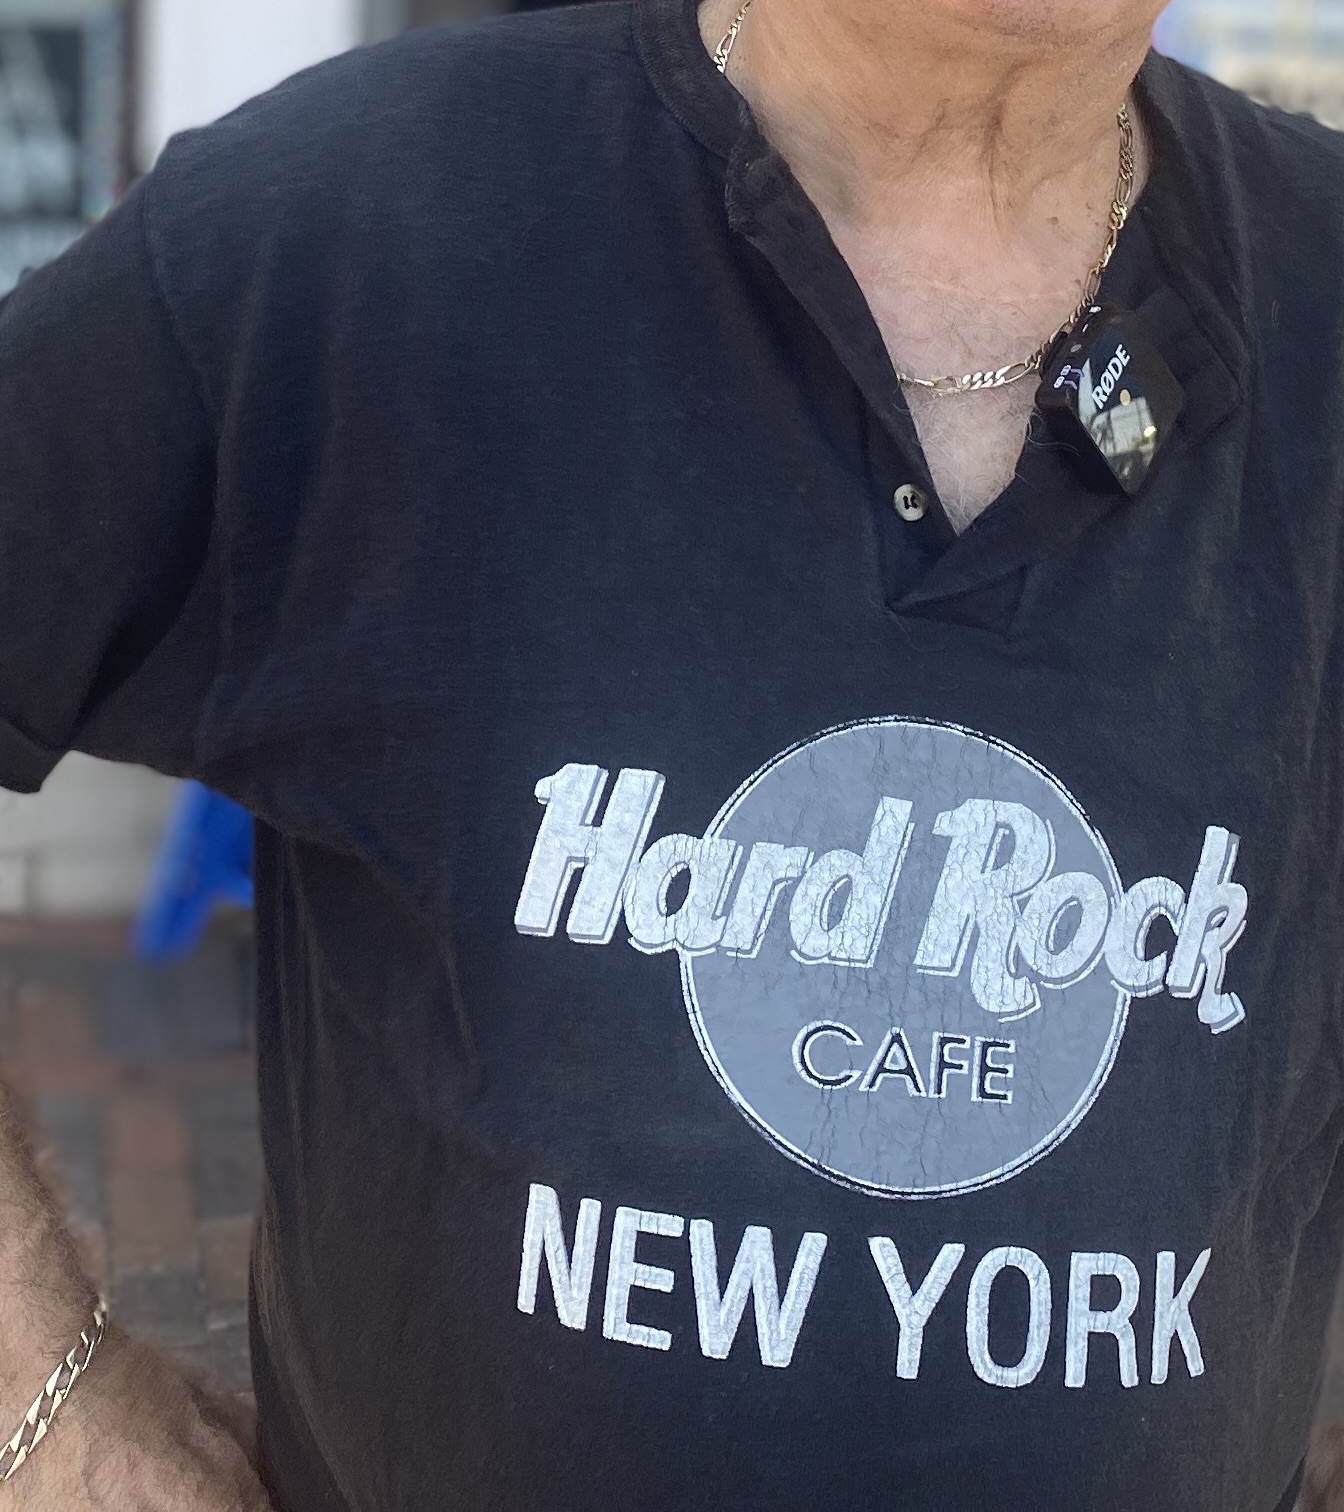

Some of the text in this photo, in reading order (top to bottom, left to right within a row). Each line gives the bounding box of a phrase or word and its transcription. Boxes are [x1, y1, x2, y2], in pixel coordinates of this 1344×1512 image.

[513, 762, 1250, 1035] Hard Rock
[790, 1020, 1018, 1106] CAFE
[515, 1181, 1214, 1390] NEW YORK
